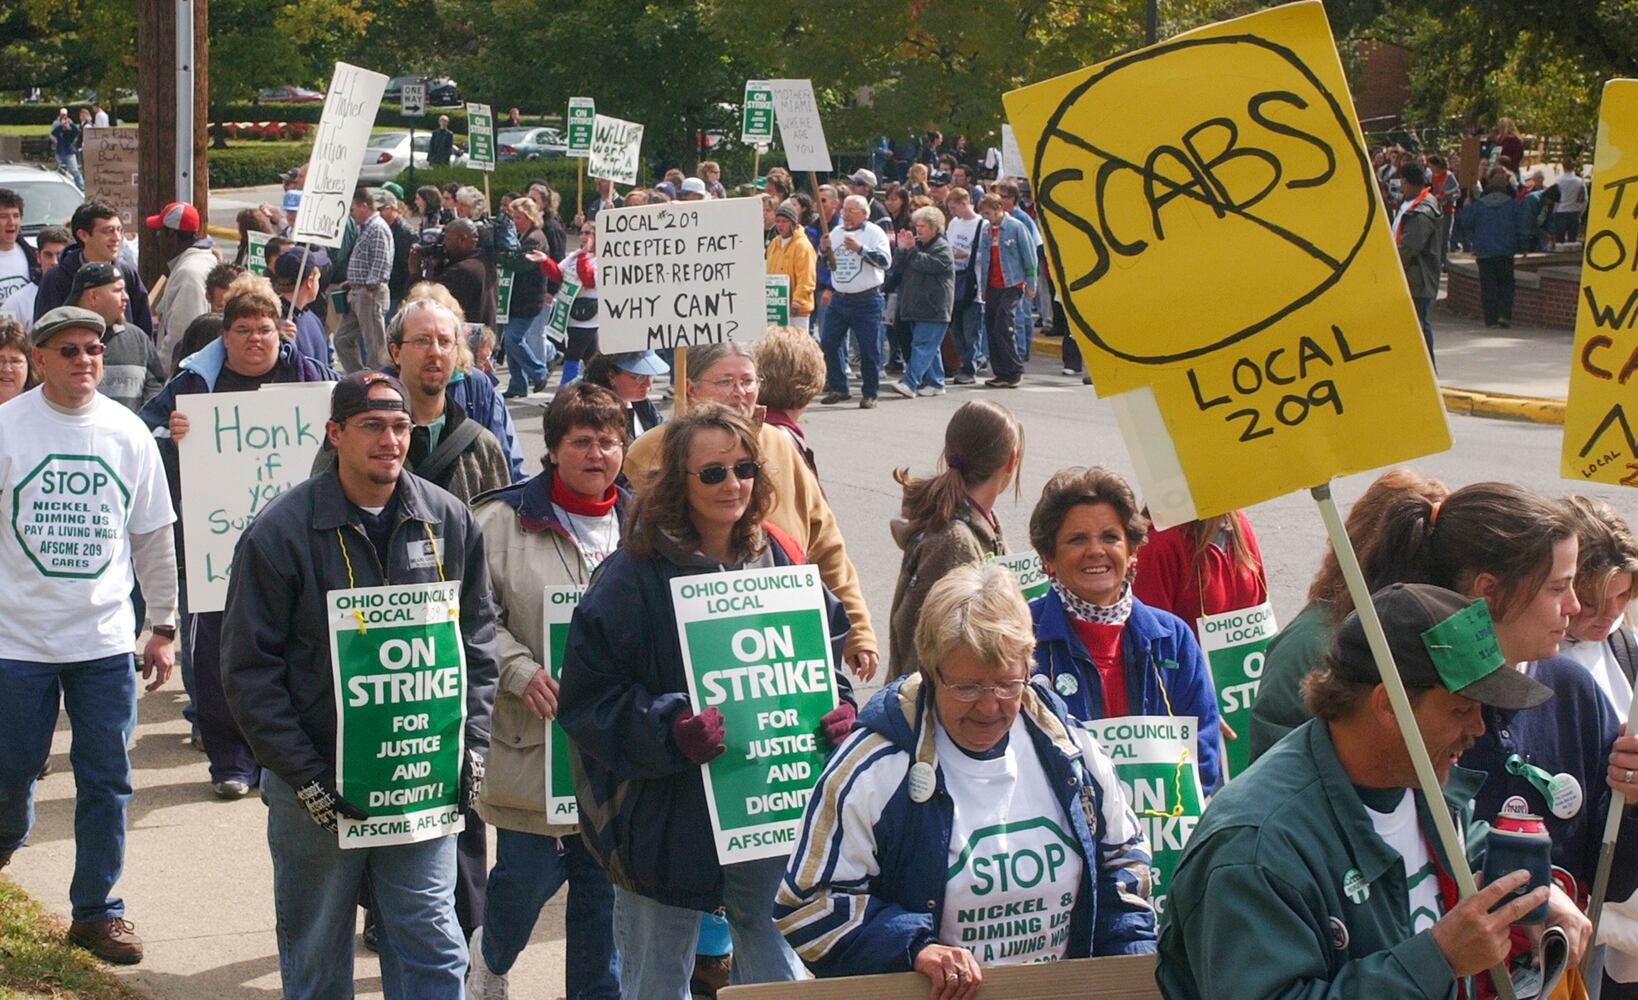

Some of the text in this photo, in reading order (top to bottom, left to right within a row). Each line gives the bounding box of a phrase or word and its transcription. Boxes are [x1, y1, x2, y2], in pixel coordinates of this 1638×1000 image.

[404, 95, 423, 104] WAY
[405, 86, 423, 94] ONE
[753, 93, 767, 101] ON
[575, 109, 588, 118] ON
[781, 100, 812, 113] MIAMI
[474, 117, 486, 126] ON
[625, 155, 633, 168] A
[1038, 90, 1337, 292] SCABS
[605, 214, 659, 233] LOCAL
[602, 233, 743, 258] ACCEPTED FACT-
[602, 262, 736, 286] FINDER-REPORT
[604, 295, 661, 319] WHY
[673, 288, 737, 318] CAN'T
[647, 320, 739, 350] MIAMI?
[1187, 325, 1391, 411] LOCAL
[1225, 380, 1344, 442] 209
[214, 405, 319, 454] Honk
[255, 453, 282, 482] if
[1581, 451, 1621, 478] LOCAL
[41, 470, 108, 496] STOP
[33, 501, 111, 513] NICKEL &
[35, 513, 110, 526] DIMING US
[24, 525, 118, 540] PAY A LIVING WAGE
[40, 541, 102, 556] AFSCME 209
[52, 558, 89, 568] CARES
[680, 573, 814, 599] OHIO COUNCIL 8
[336, 588, 455, 610] OHIO COUNCIL 8
[707, 595, 764, 614] LOCAL
[361, 608, 415, 624] LOCAL
[1205, 616, 1243, 633] OHIO
[731, 625, 795, 663] ON
[1225, 625, 1266, 643] LOCAL
[379, 636, 436, 670] ON
[348, 666, 459, 707] STRIKE
[702, 659, 828, 706] STRIKE
[392, 713, 430, 733] FOR
[757, 708, 800, 731] FOR
[1103, 724, 1190, 740] COUNCIL 8
[376, 735, 441, 759] JUSTICE
[745, 733, 817, 760] JUSTICE
[391, 760, 431, 782] AND
[766, 761, 811, 784] AND
[745, 788, 813, 815] DIGNIT
[346, 810, 459, 838] AFSCME, AFL-CIO
[727, 828, 796, 851] AFSCME
[970, 843, 1065, 896] STOP
[957, 892, 1072, 923] NICKEL &
[962, 917, 1041, 942] DIMING
[983, 943, 994, 962] A
[1000, 935, 1046, 958] LIVING
